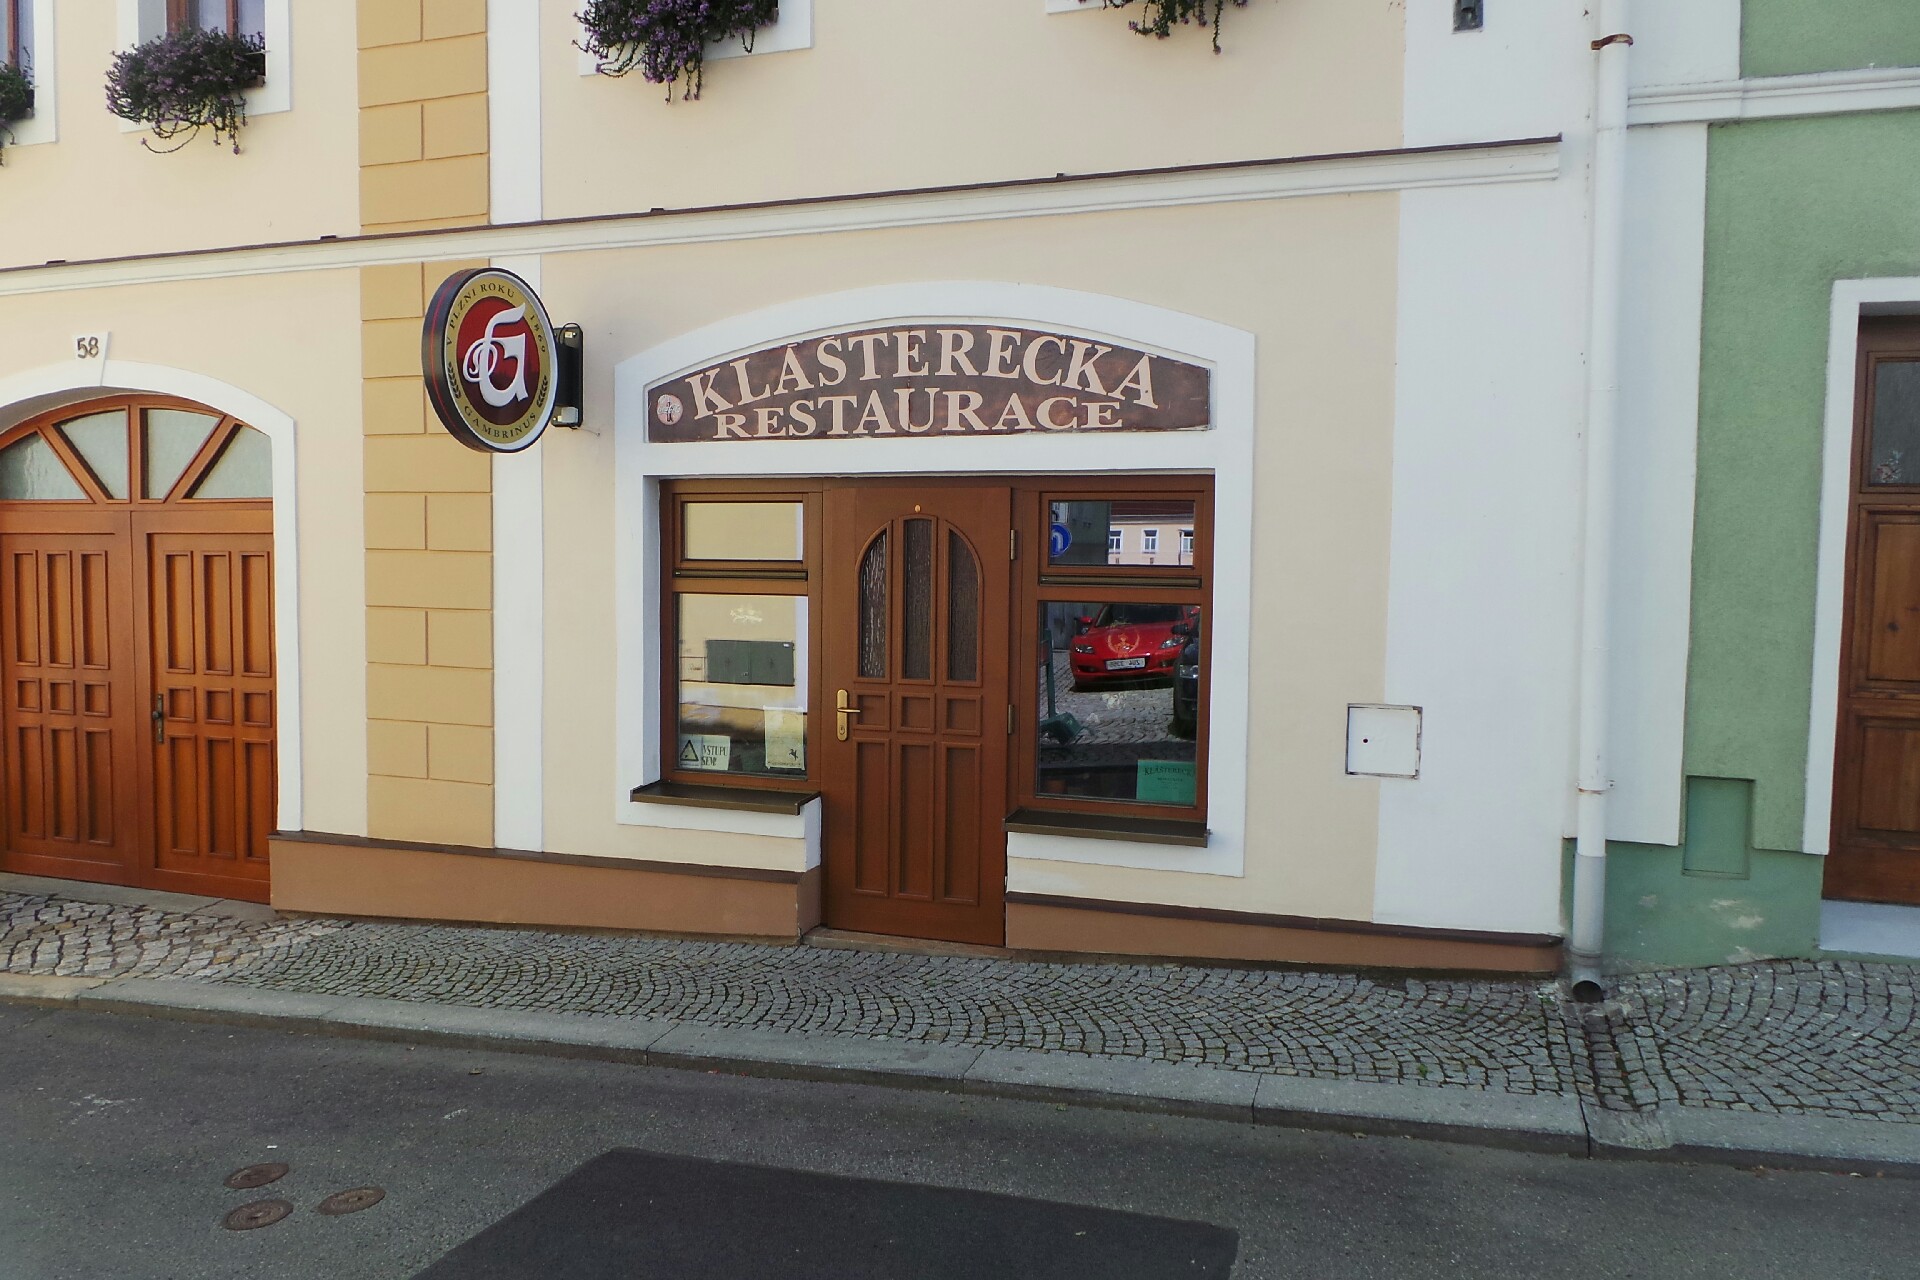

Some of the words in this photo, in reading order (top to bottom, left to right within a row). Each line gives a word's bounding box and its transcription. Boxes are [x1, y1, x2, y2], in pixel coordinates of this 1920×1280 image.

[480, 282, 515, 298] ROKU
[77, 336, 99, 359] 58
[464, 405, 537, 439] GAMBRINUS
[713, 387, 1123, 439] RESTAURACE
